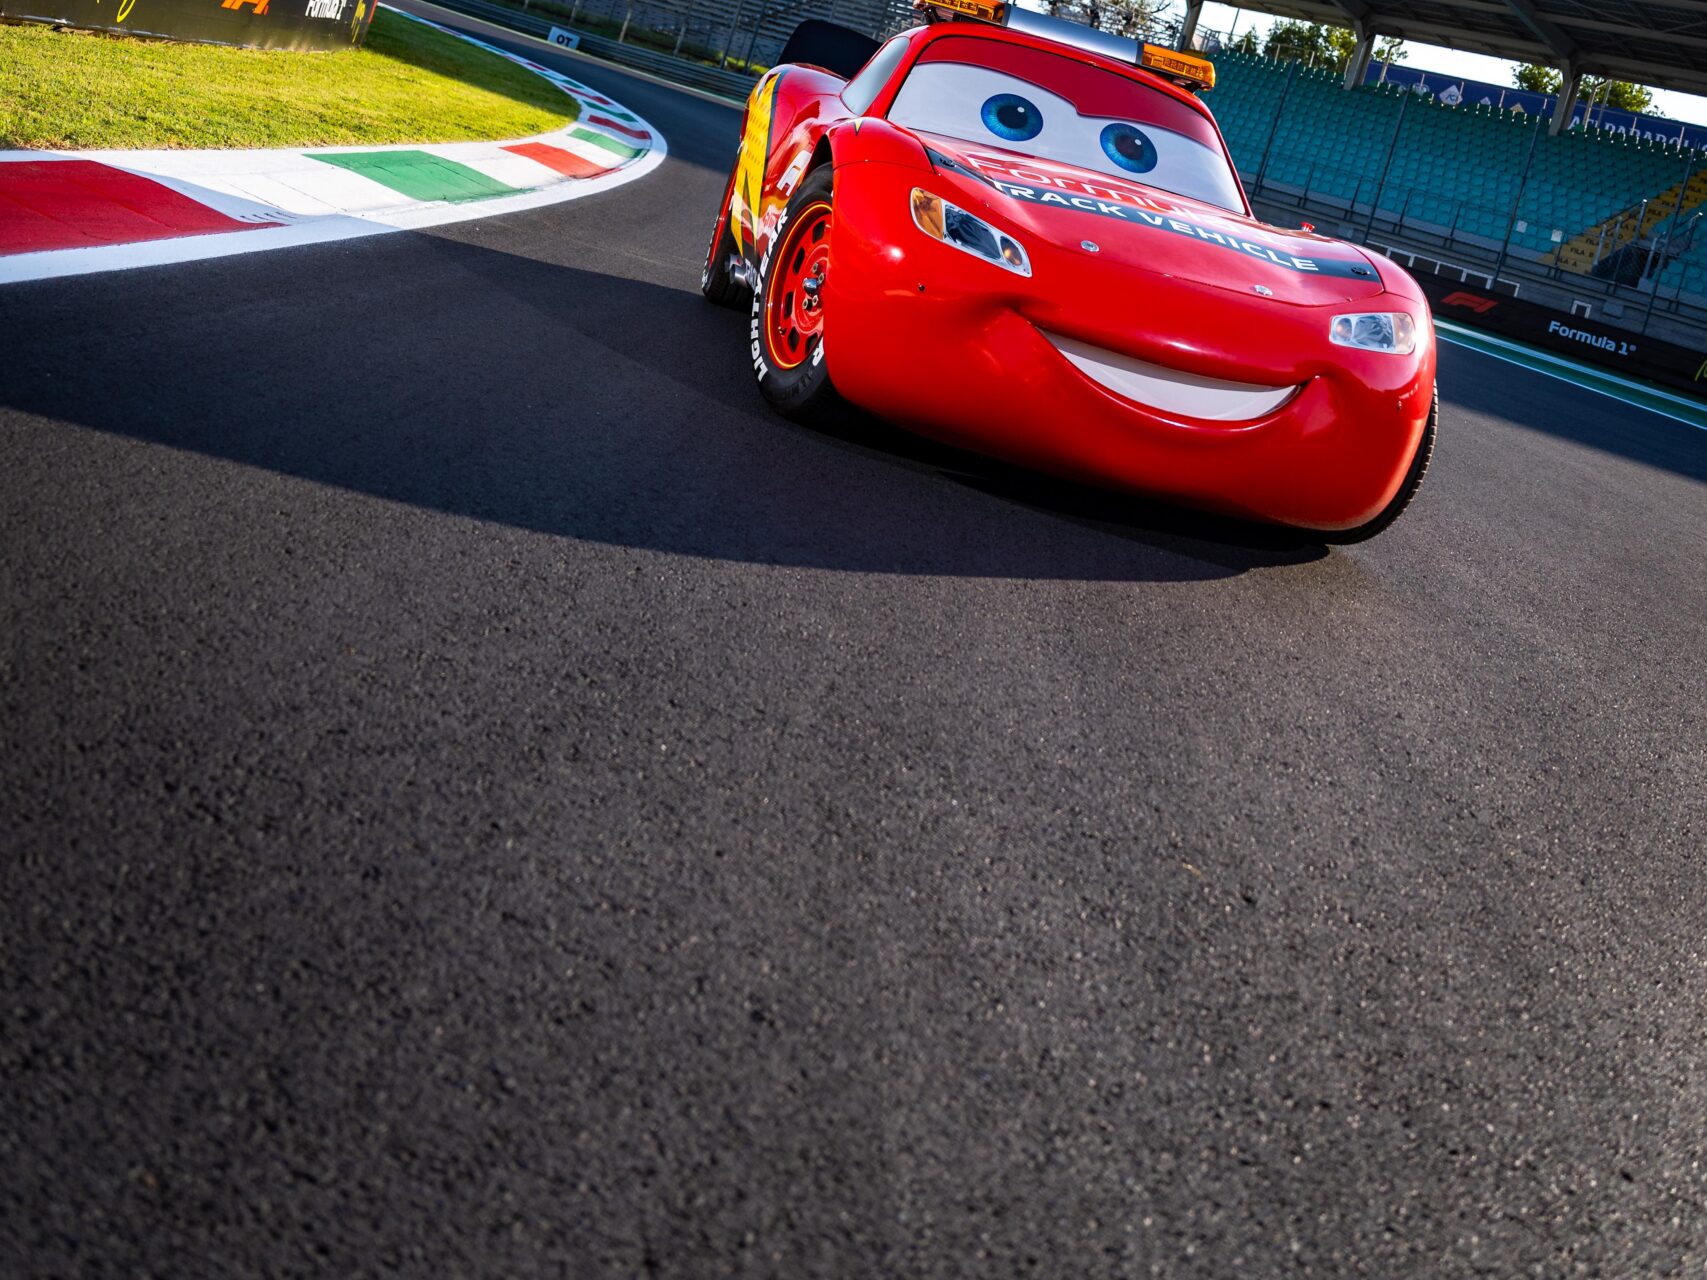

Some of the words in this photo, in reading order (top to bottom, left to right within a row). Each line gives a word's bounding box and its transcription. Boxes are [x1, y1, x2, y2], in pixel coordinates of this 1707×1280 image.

[984, 175, 1128, 218] TRACK
[1137, 210, 1319, 271] VEHICLE
[750, 207, 788, 382] LIGHTYEAR
[1440, 291, 1499, 313] F1
[1548, 319, 1617, 352] Formula
